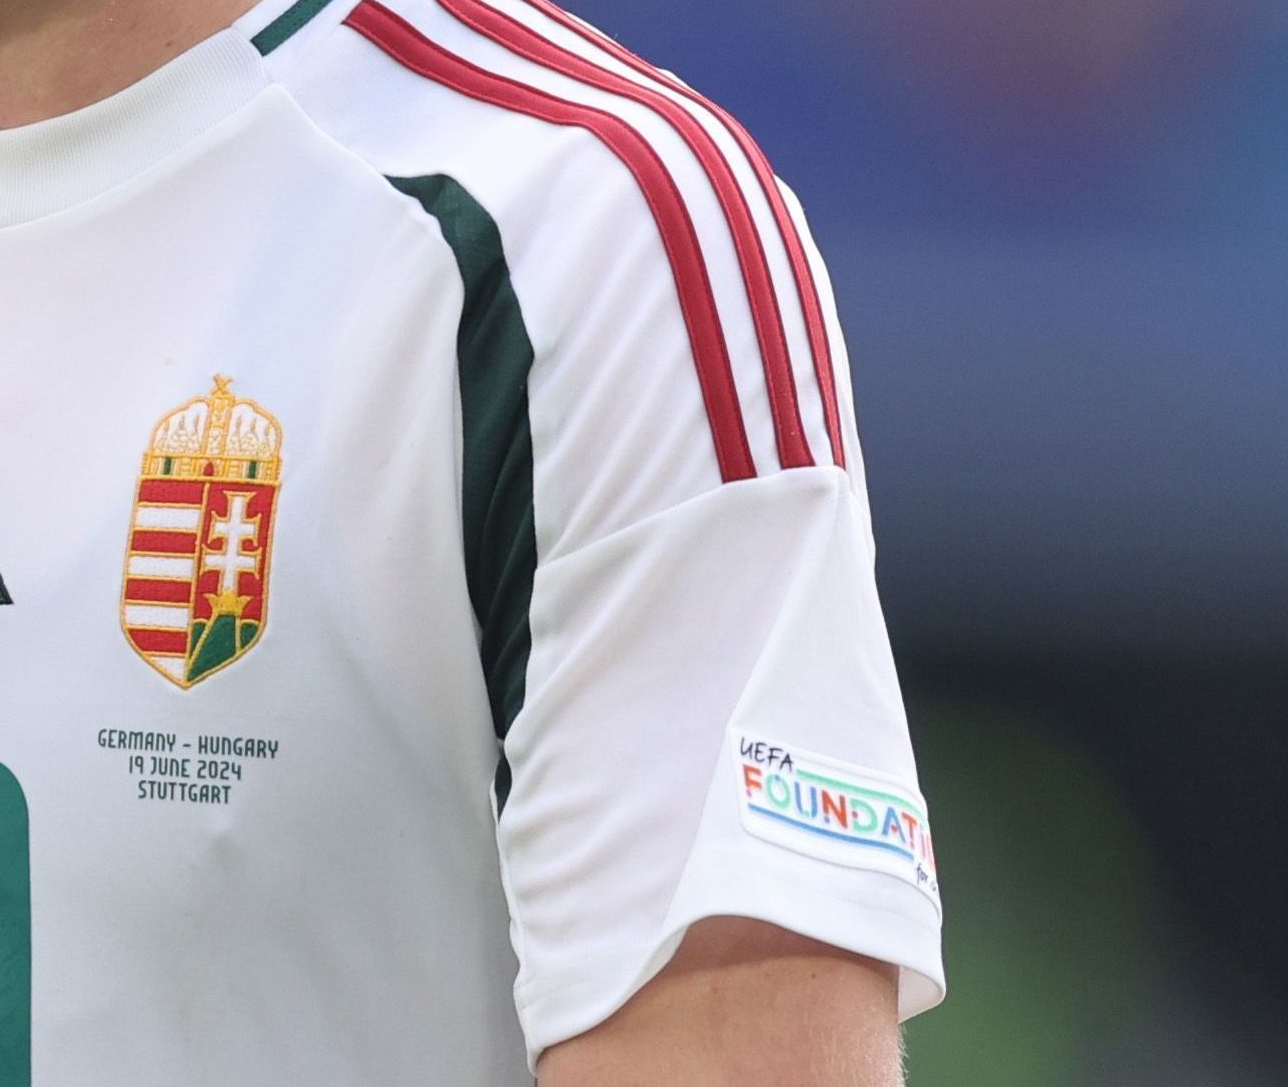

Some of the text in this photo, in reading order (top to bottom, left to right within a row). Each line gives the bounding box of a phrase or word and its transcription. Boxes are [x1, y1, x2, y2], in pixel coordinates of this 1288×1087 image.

[98, 728, 176, 752] GERMANY
[198, 735, 279, 759] HUNGARY
[740, 736, 794, 772] UEFA
[129, 755, 242, 781] 19 JUNE 2024
[138, 780, 232, 804] STUTTGART
